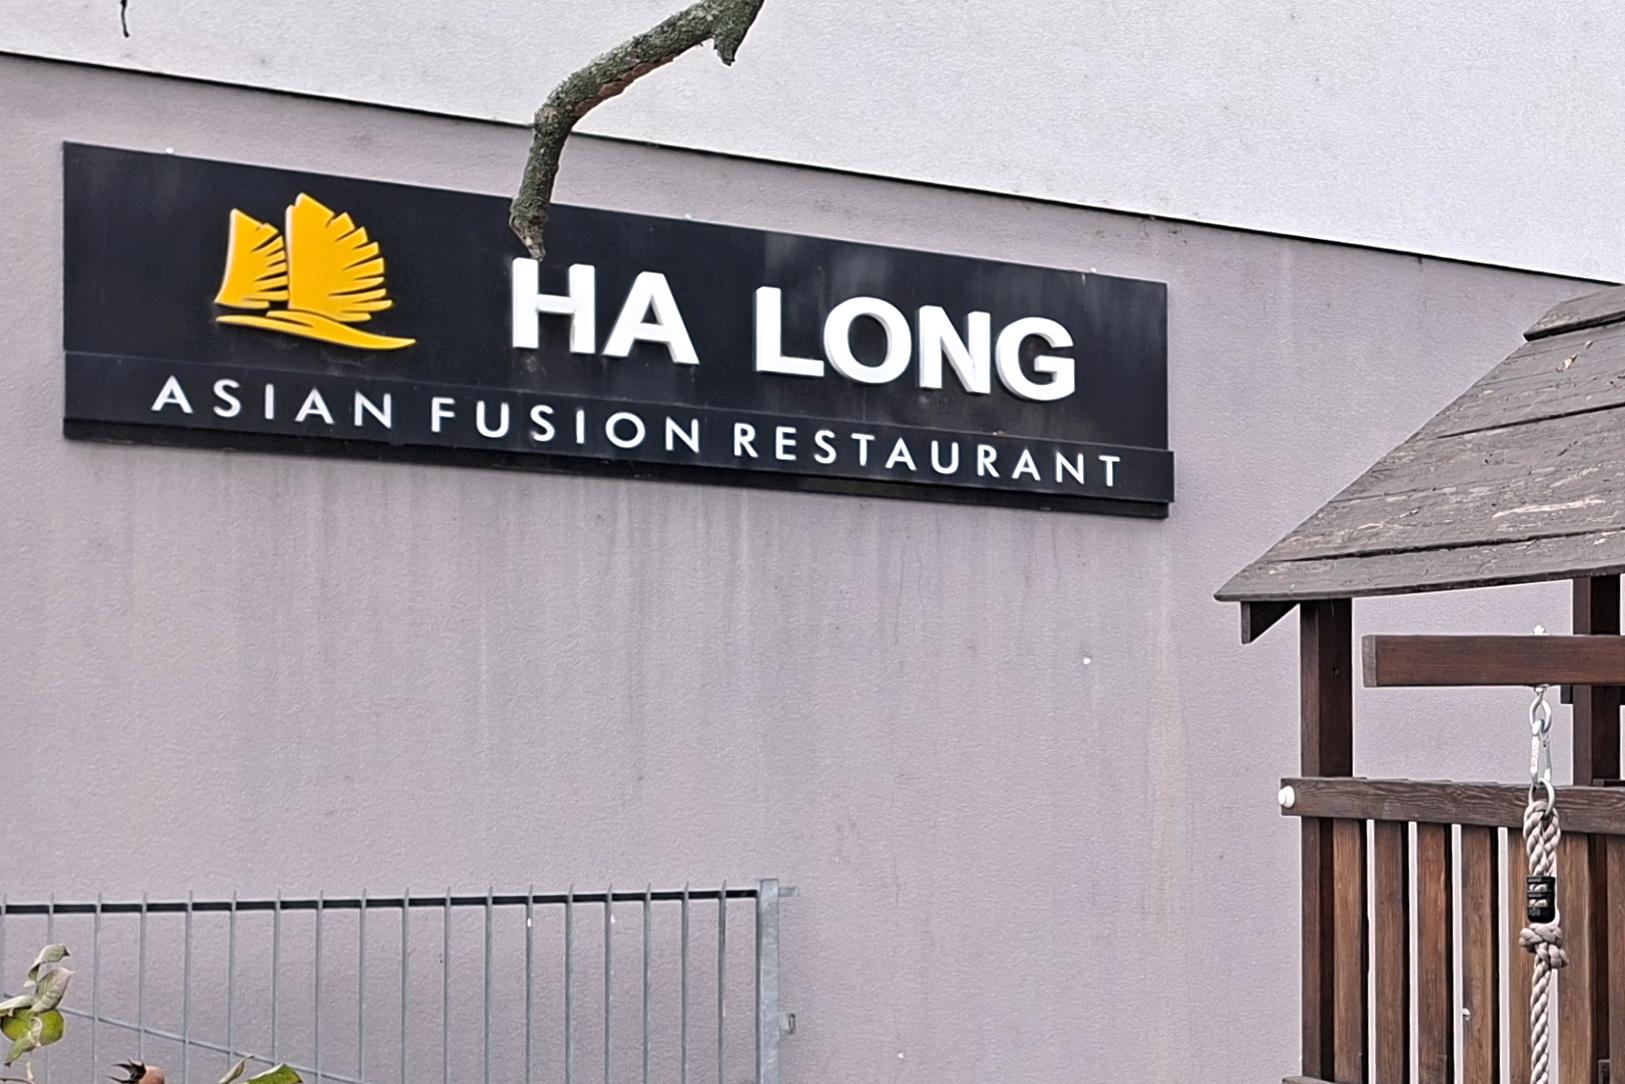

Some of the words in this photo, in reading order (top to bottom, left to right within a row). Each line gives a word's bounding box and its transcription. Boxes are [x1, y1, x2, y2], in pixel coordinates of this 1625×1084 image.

[512, 257, 700, 365] HA
[756, 286, 1075, 401] LONG
[151, 375, 392, 429] ASIAN
[431, 397, 699, 454] FUSION
[733, 422, 1121, 487] RESTAURANT
